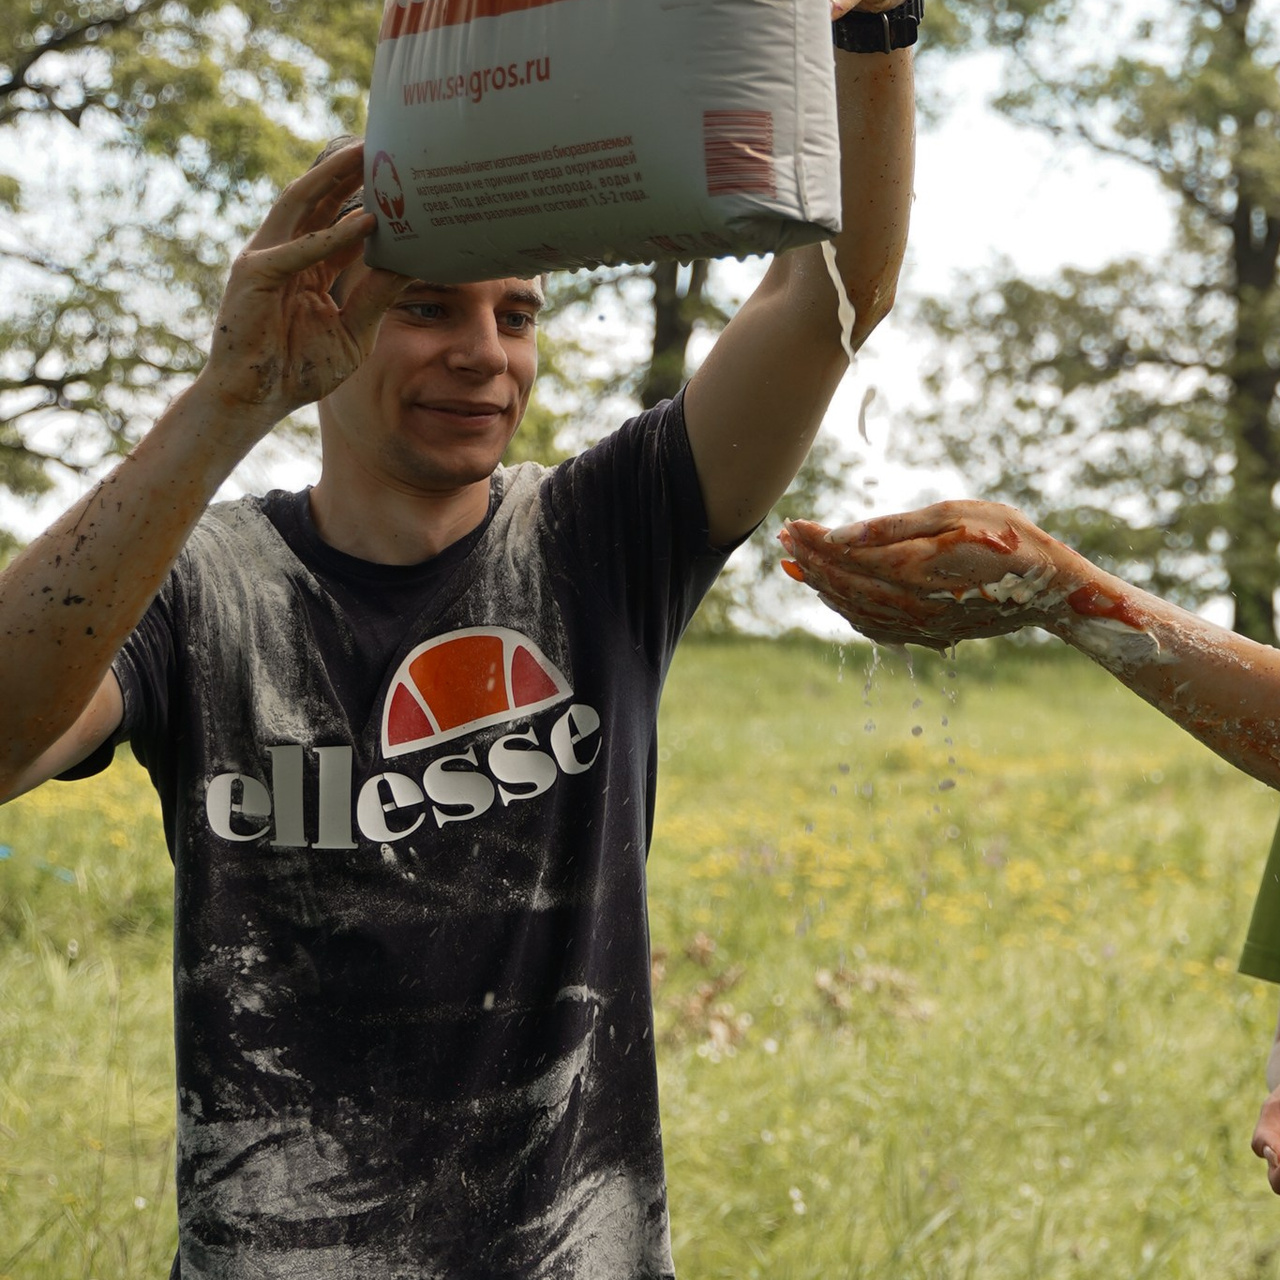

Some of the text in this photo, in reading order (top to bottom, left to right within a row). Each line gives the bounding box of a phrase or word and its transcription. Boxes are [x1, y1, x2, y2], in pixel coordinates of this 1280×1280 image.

[416, 150, 637, 197] материалов и не причинит вреда окружающей
[494, 152, 541, 169] изготовлен
[541, 149, 553, 161] из
[553, 136, 634, 160] биоразлагаемых
[422, 170, 643, 214] среде. Под действием кислорода, воды и
[430, 189, 650, 227] света время разложения составит 1,5-2 года.
[206, 704, 603, 850] ellesse
